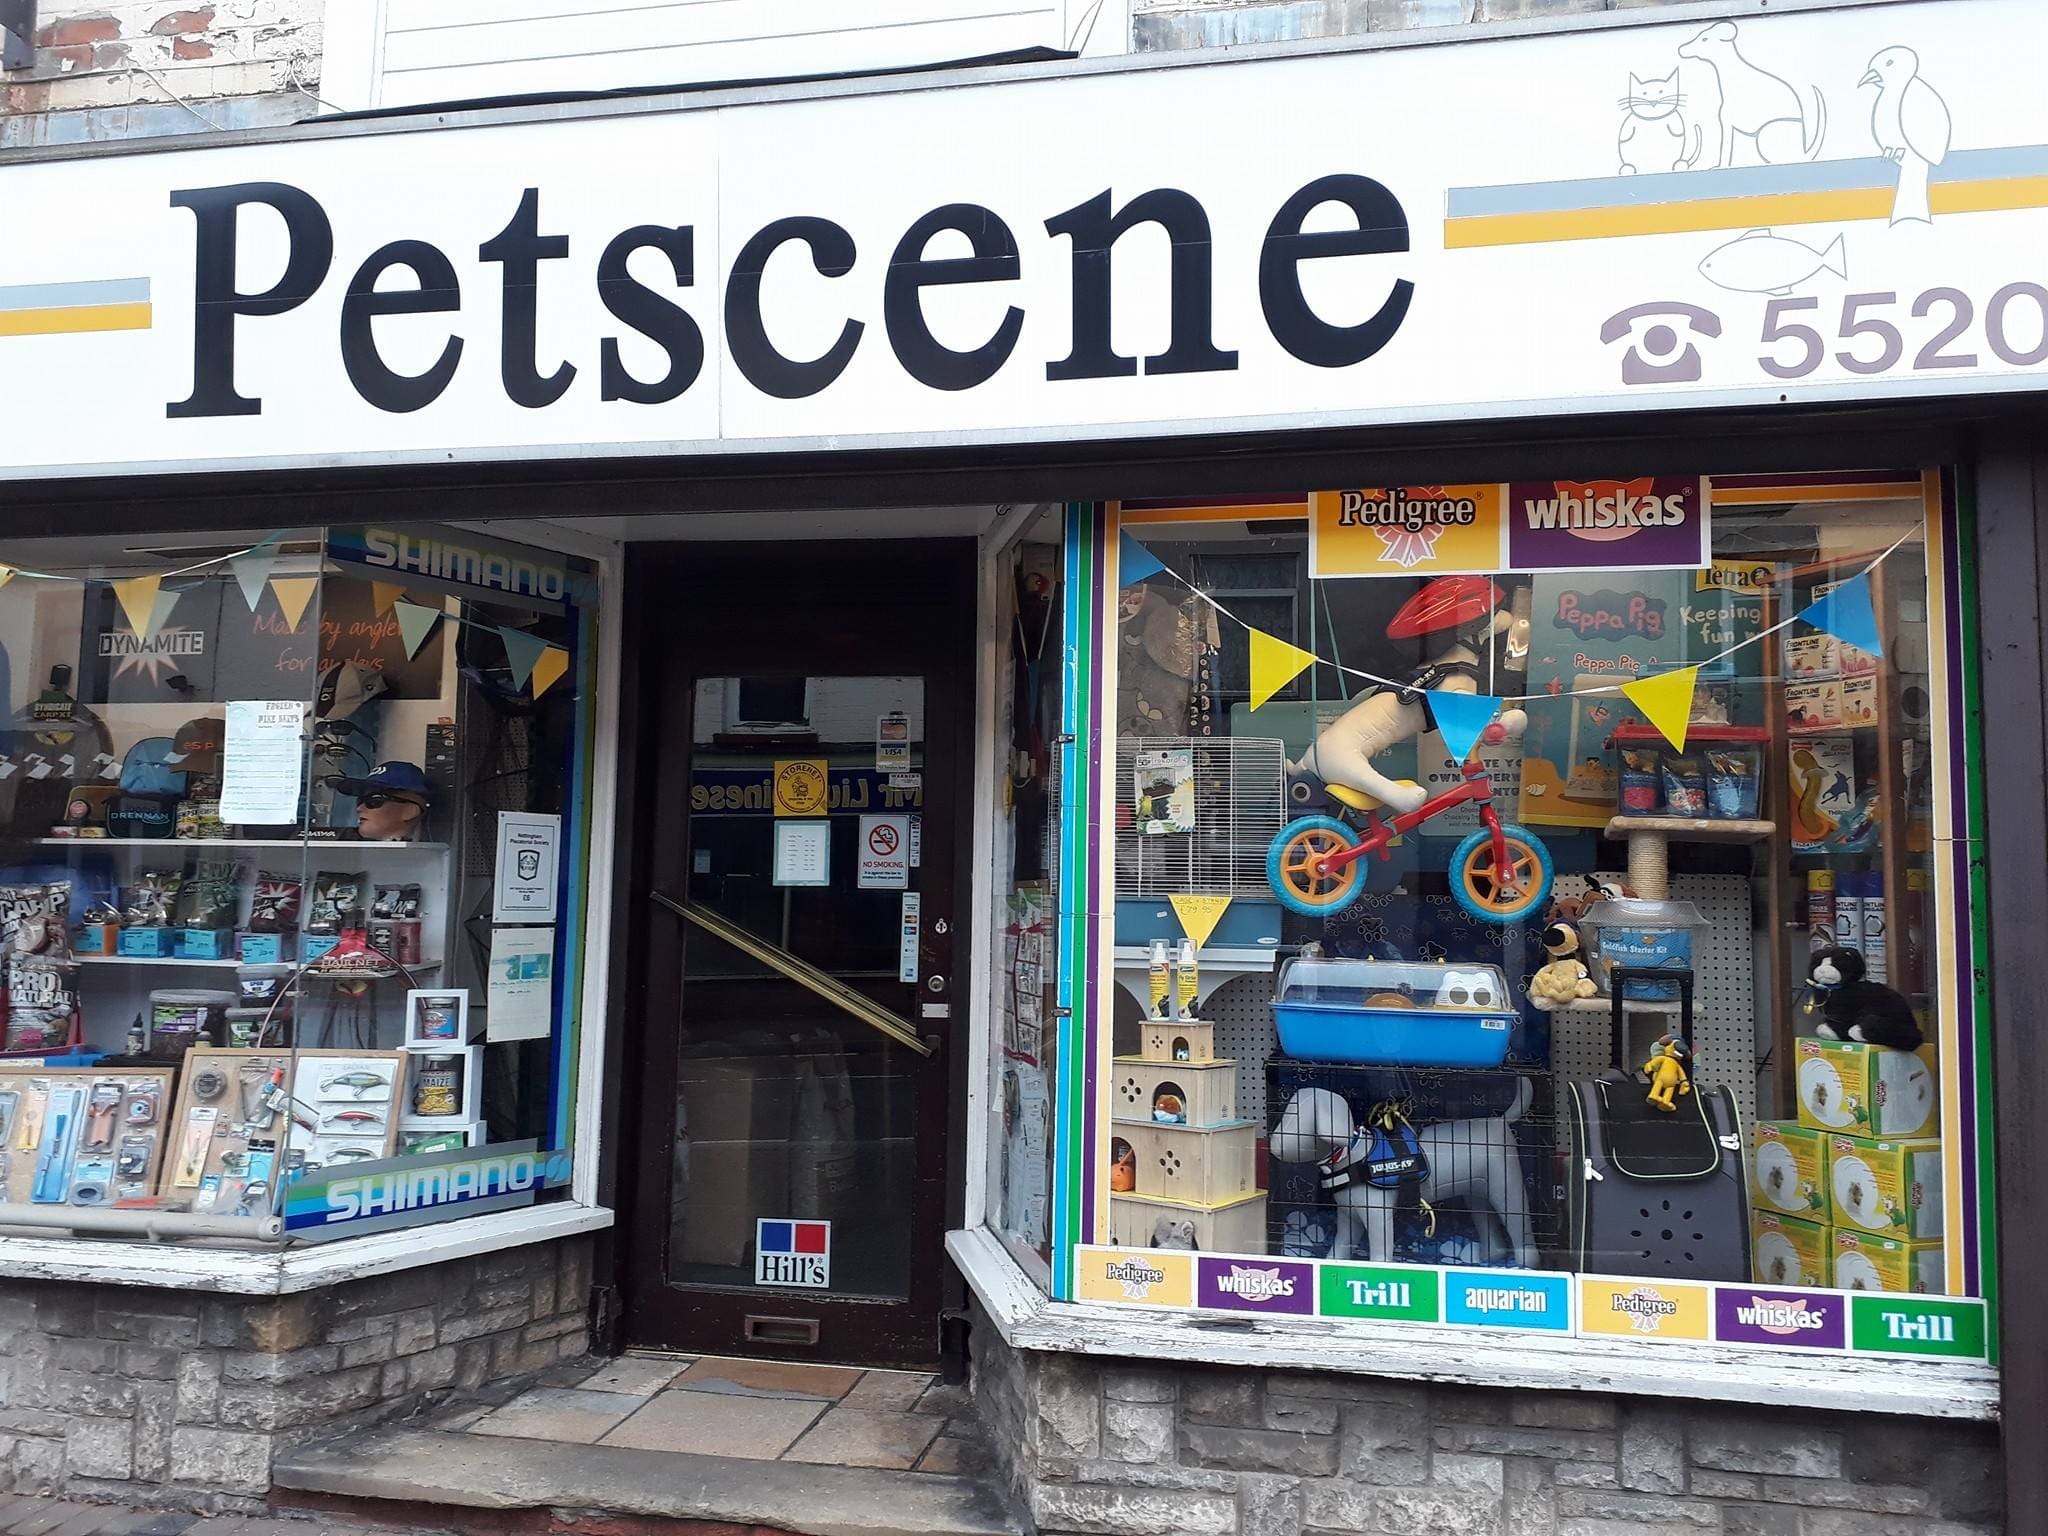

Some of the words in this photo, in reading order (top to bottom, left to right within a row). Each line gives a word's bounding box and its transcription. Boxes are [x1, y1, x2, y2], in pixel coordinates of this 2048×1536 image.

[167, 173, 1415, 418] Petscene
[1758, 282, 2048, 379] 5520
[1340, 488, 1475, 532] Pedigree
[1525, 489, 1685, 531] whiskas
[365, 528, 564, 601] SHIMANO
[1559, 594, 1624, 633] Peppa
[1629, 597, 1664, 634] Pig
[1680, 604, 1761, 625] Keeping
[320, 610, 341, 651] by
[349, 611, 402, 650] angle
[1700, 623, 1735, 645] fun
[99, 632, 204, 656] DYNAMITE
[1786, 638, 1820, 649] FRONTLINE
[273, 647, 312, 672] for
[1574, 652, 1615, 673] Peppa
[1785, 687, 1820, 698] FRONTLINE
[1843, 679, 1872, 690] FRONTLINE
[782, 764, 821, 781] STORENET
[111, 811, 169, 821] DRENNAN
[0, 892, 66, 923] CARP
[9, 970, 57, 992] PRO
[9, 990, 73, 1007] NATURAL
[422, 1076, 451, 1089] MAIZE
[326, 1156, 535, 1222] SHIMANO
[760, 1255, 826, 1285] Hill's
[1106, 1262, 1164, 1284] Pedigree
[1217, 1266, 1294, 1297] whiskas
[1346, 1279, 1412, 1308] Trill
[1465, 1286, 1547, 1314] aquarian
[1611, 1293, 1677, 1316] Pedigree
[1736, 1304, 1824, 1329] whiskas
[1881, 1311, 1955, 1342] Trill
